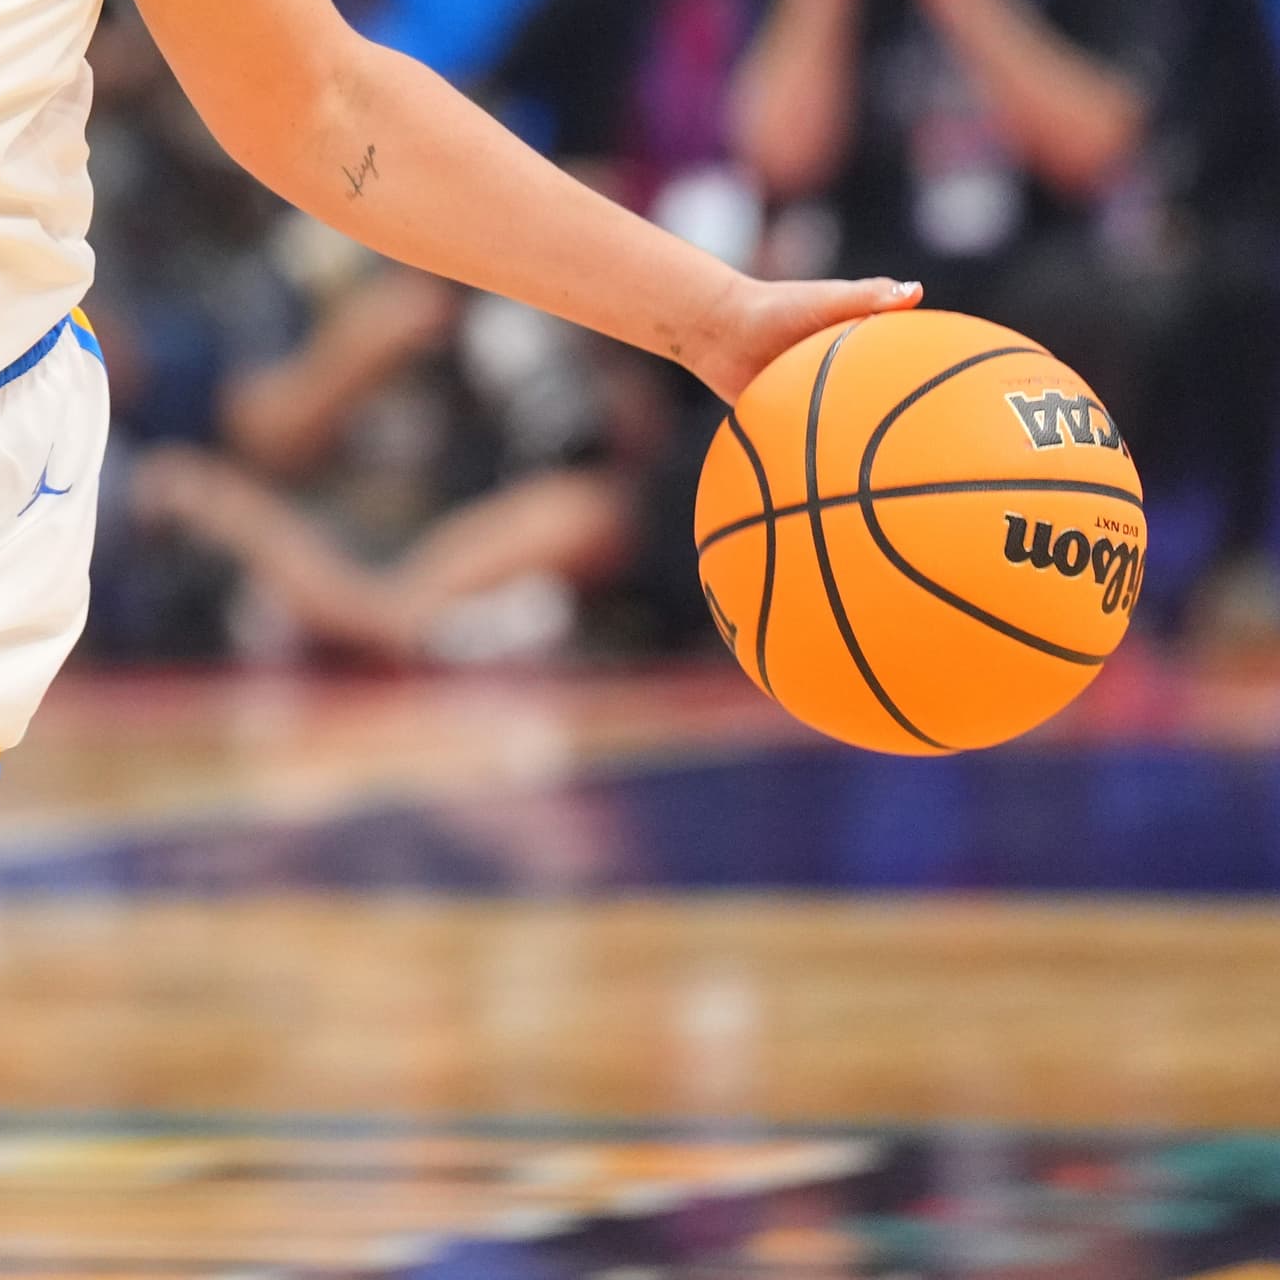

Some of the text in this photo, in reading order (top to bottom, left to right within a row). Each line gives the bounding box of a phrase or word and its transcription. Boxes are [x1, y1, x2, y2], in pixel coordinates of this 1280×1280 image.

[1006, 391, 1130, 460] CAA
[1094, 515, 1120, 533] NXT
[1004, 512, 1146, 618] ilson
